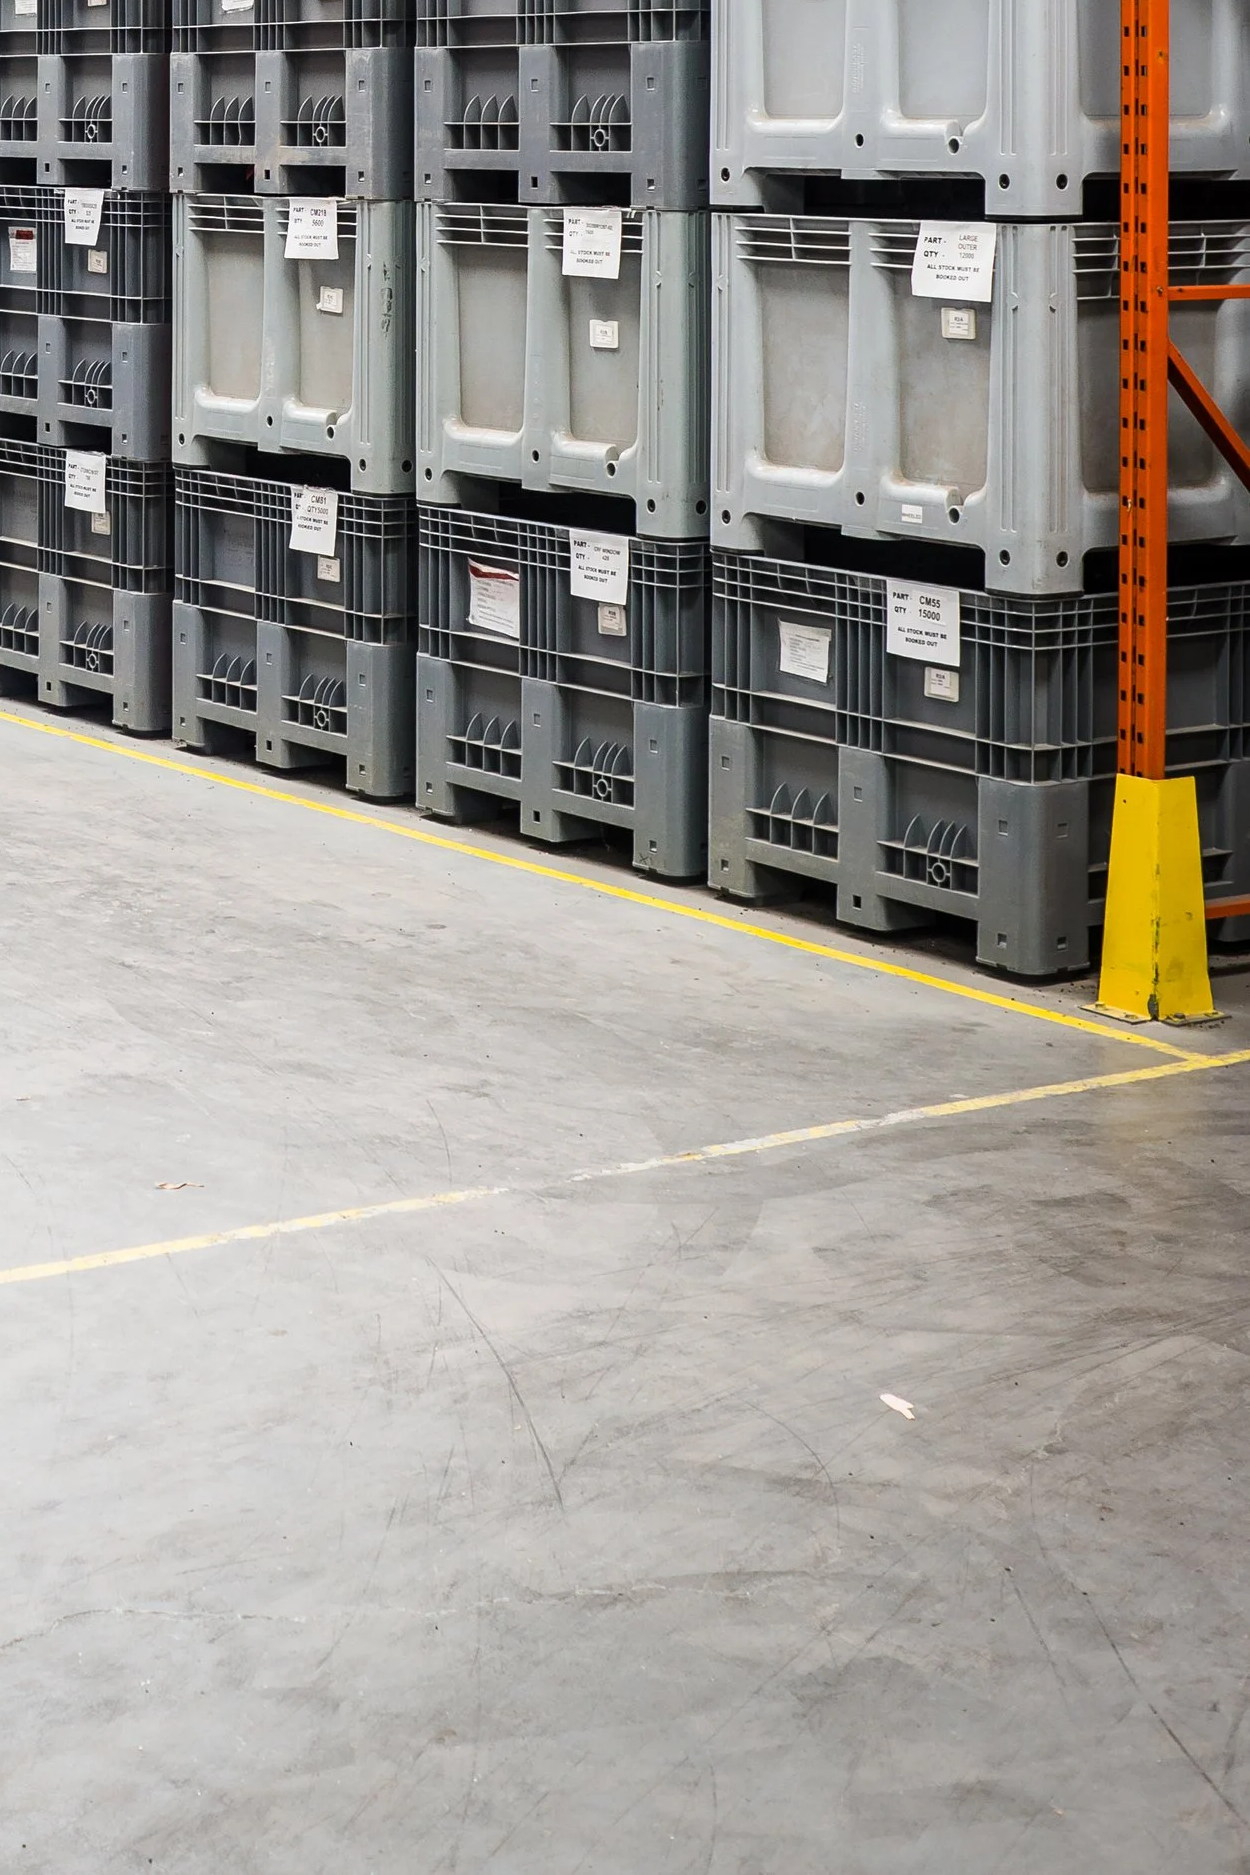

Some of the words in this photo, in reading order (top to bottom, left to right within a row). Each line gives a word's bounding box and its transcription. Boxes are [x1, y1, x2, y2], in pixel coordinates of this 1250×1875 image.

[924, 236, 942, 244] PART
[959, 234, 978, 243] LARGE
[958, 243, 978, 251] OUTER
[923, 250, 938, 258] QTY
[573, 539, 587, 548] PART
[575, 552, 586, 560] QTY
[892, 592, 909, 601] PART
[919, 595, 941, 609] CM55
[894, 605, 907, 614] QTY
[919, 609, 941, 622] 15000
[907, 628, 923, 636] STOCK
[905, 637, 925, 646] BOOKED
